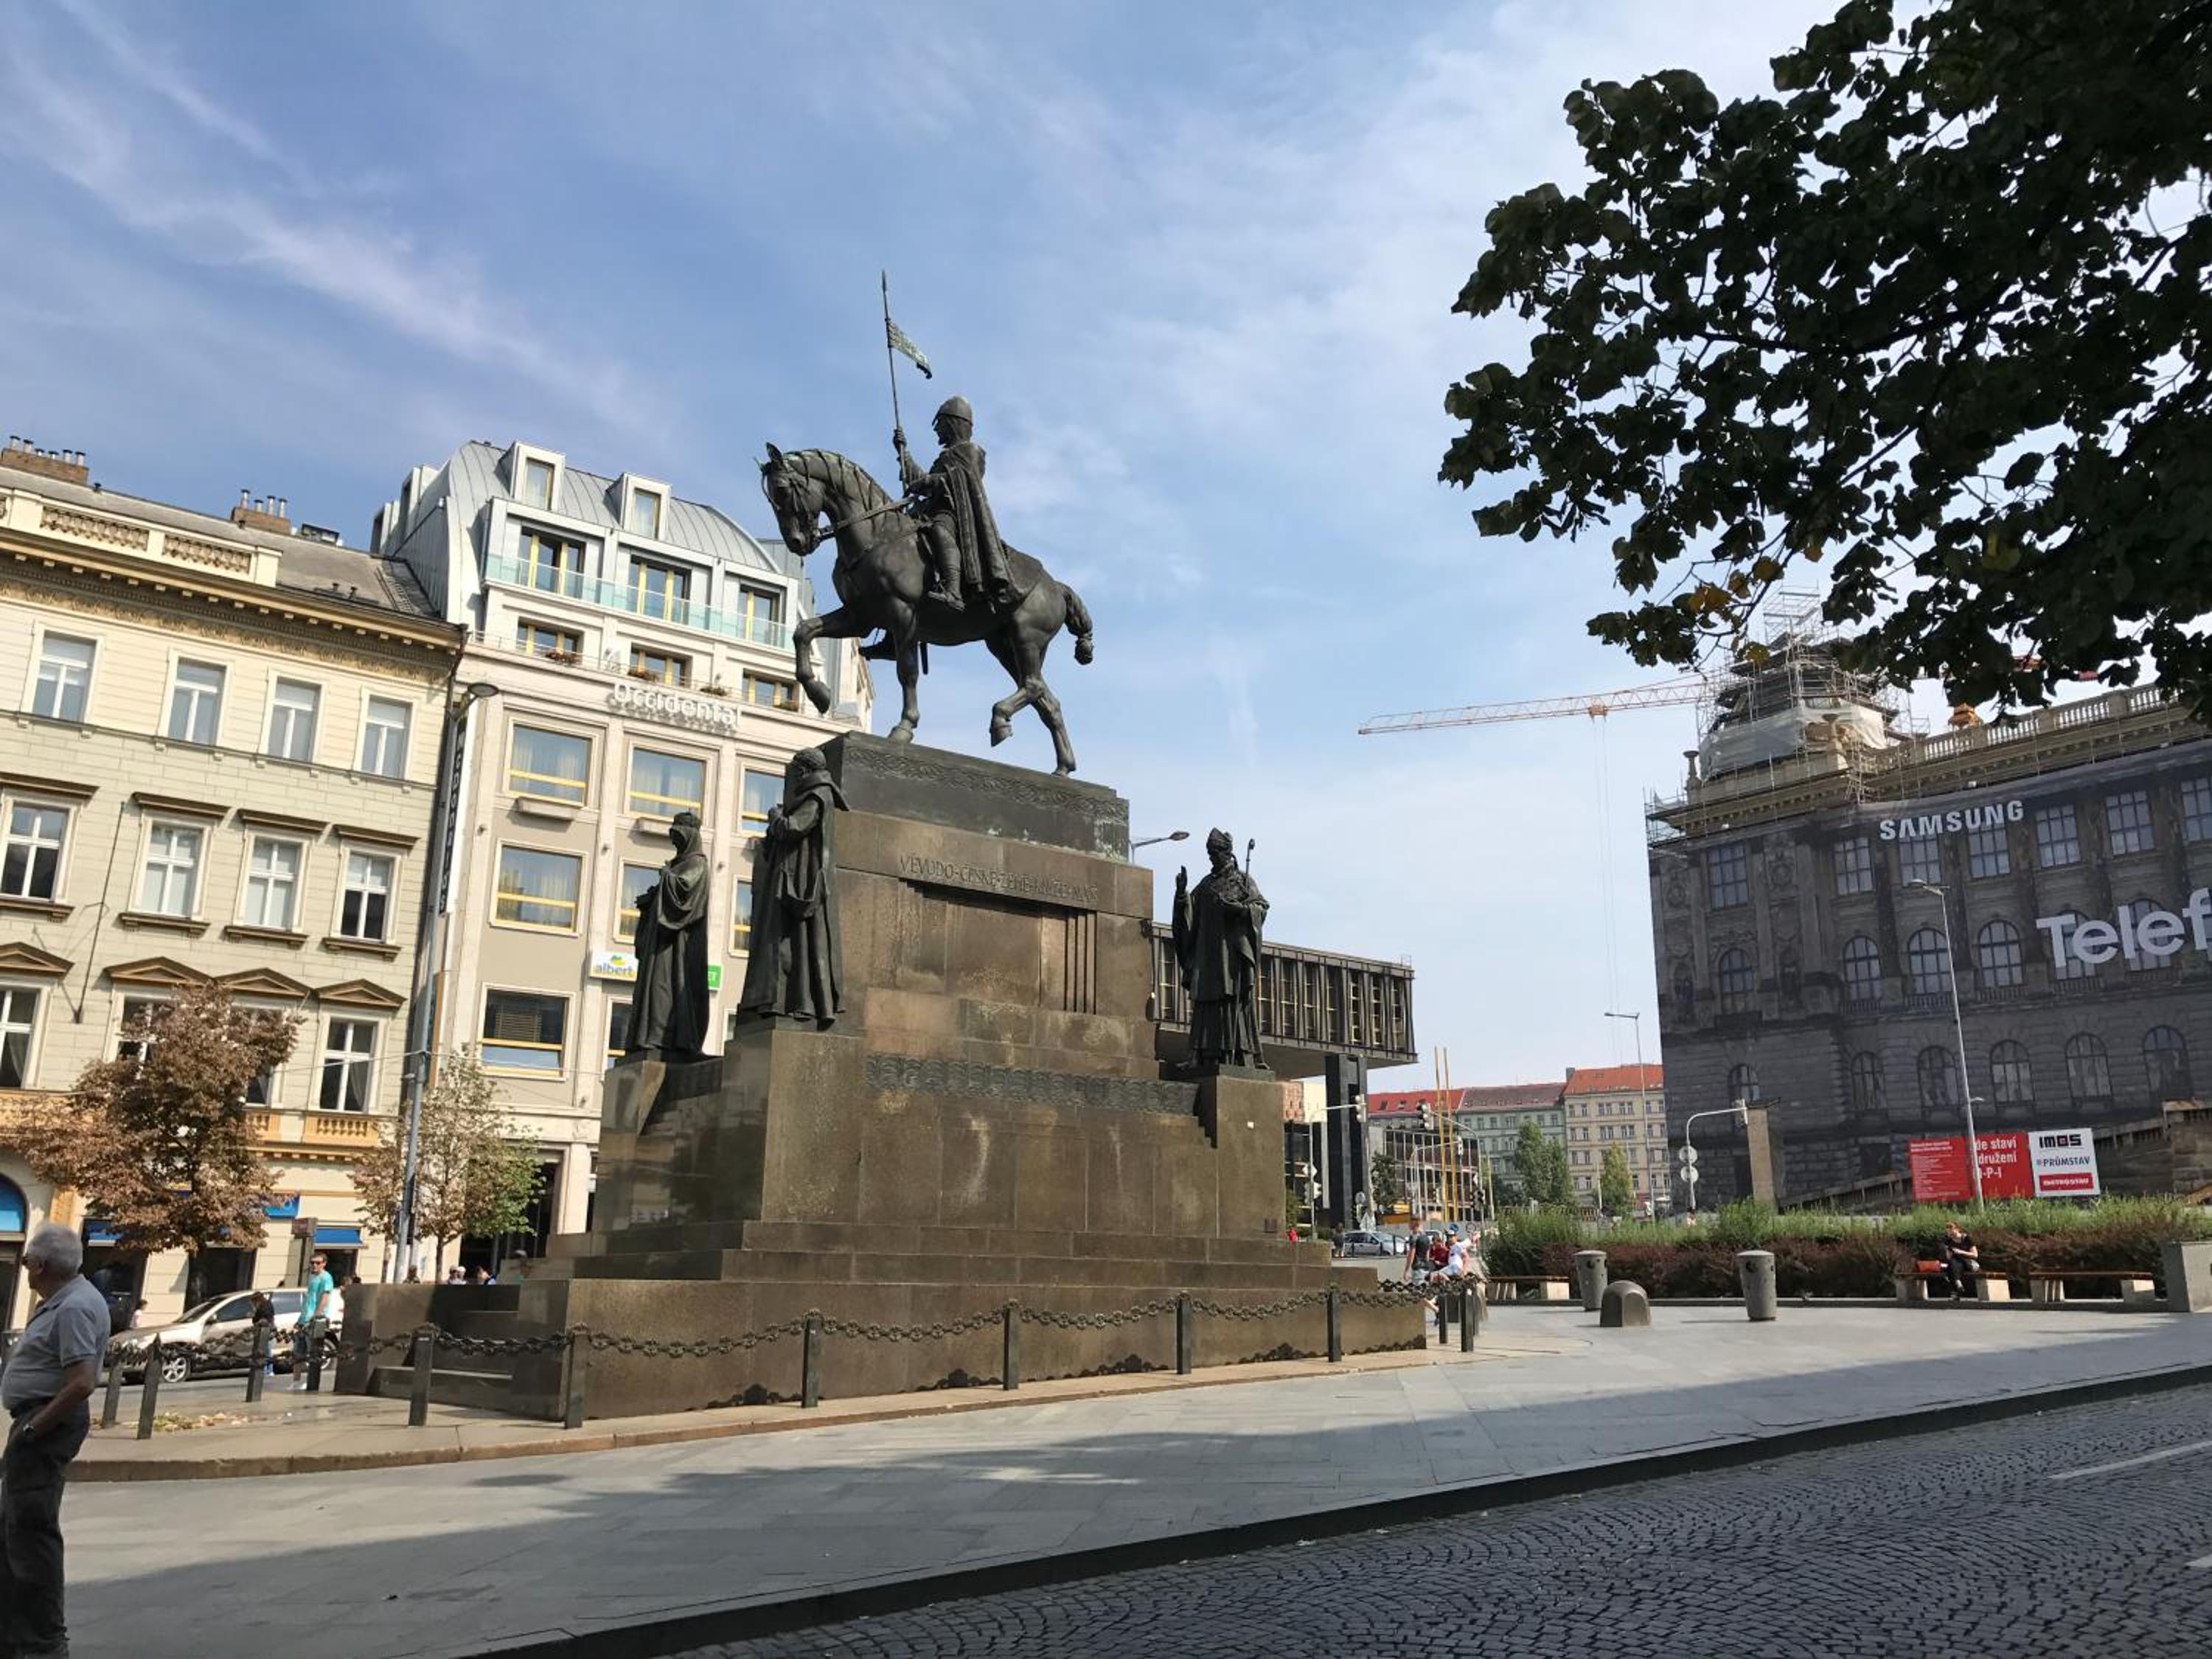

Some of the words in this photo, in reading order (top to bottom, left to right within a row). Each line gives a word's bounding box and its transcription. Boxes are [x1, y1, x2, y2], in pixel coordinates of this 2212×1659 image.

[613, 684, 743, 728] Occidental
[1879, 800, 2025, 841] SAMSUNG
[2036, 888, 2212, 968] Telef
[595, 961, 633, 975] albert
[2039, 1134, 2082, 1148] IMOS
[2043, 1155, 2090, 1167] PRŮMSTAV
